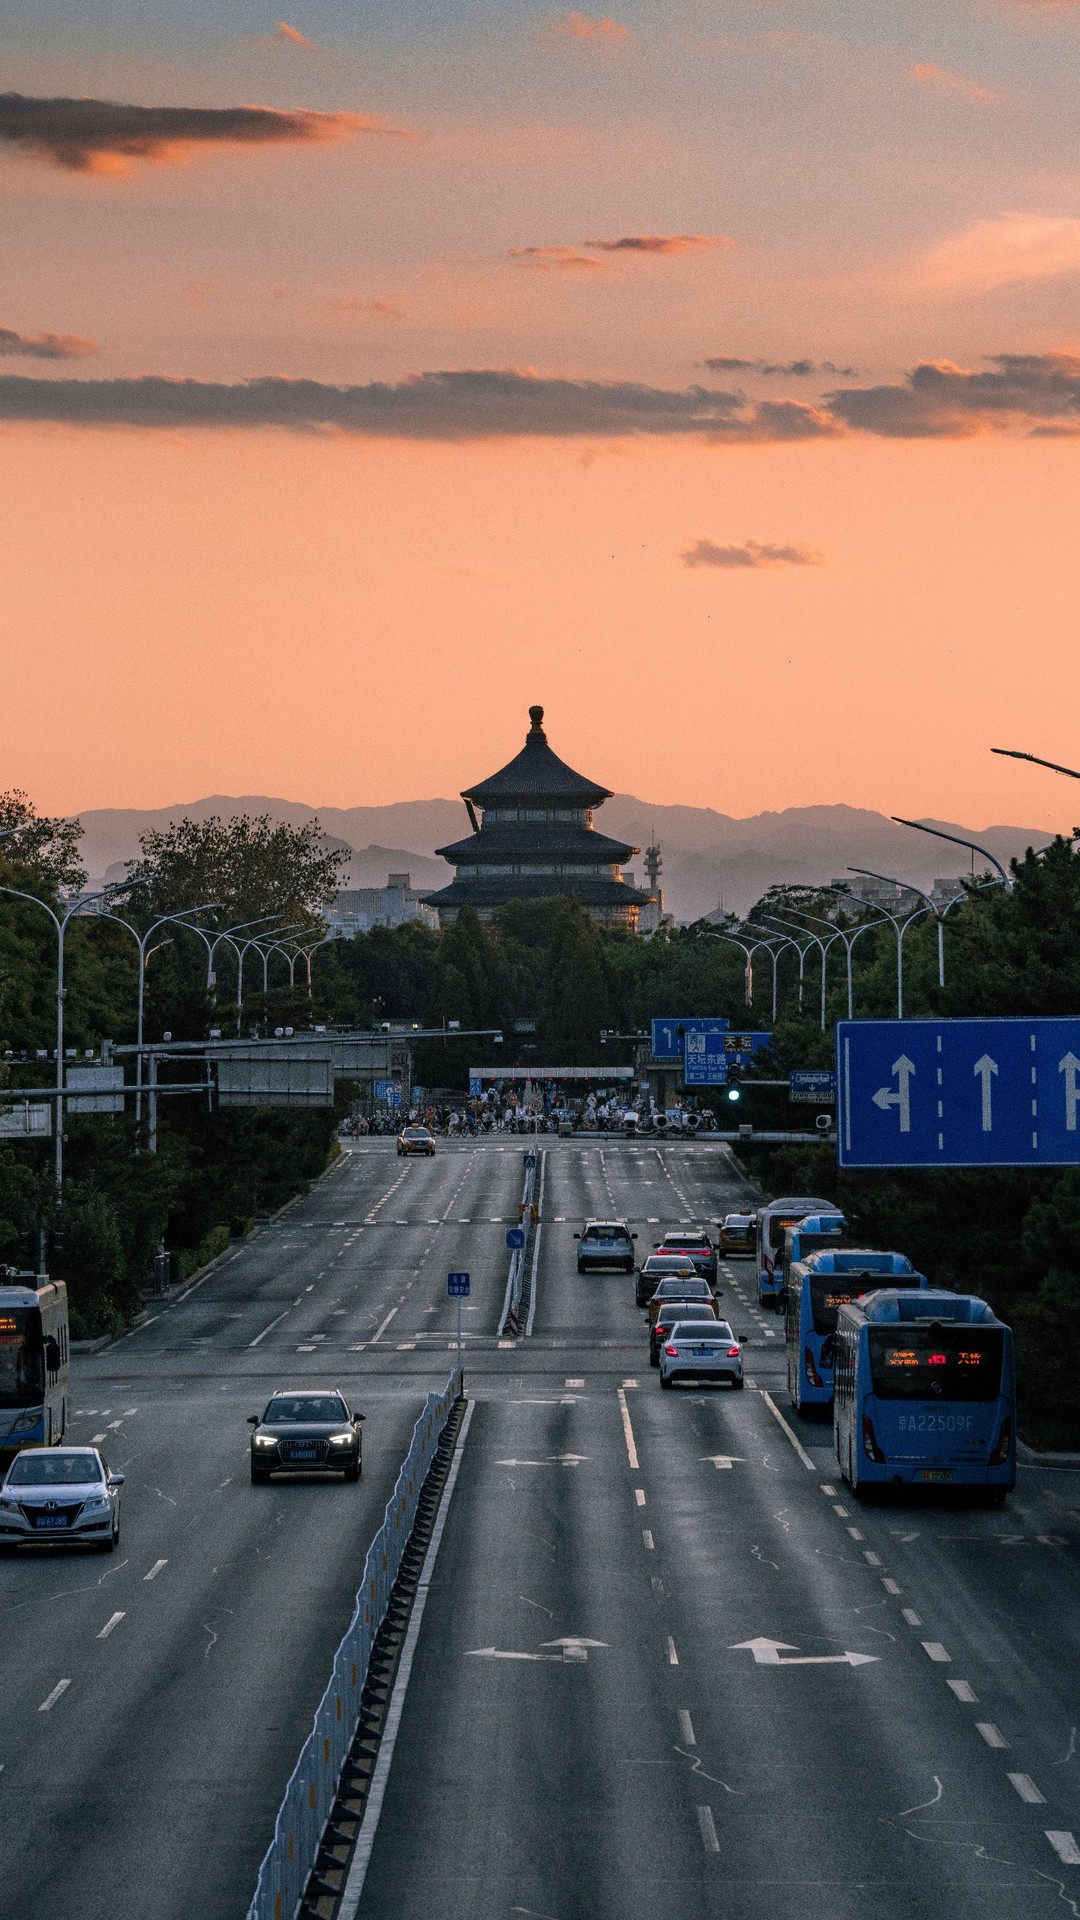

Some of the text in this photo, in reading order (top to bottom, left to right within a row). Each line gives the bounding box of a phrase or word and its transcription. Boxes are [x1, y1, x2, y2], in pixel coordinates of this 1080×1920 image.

[725, 1036, 752, 1047] 天坛
[687, 1053, 726, 1065] 天坛东路
[898, 1415, 975, 1432] 京A22509F
